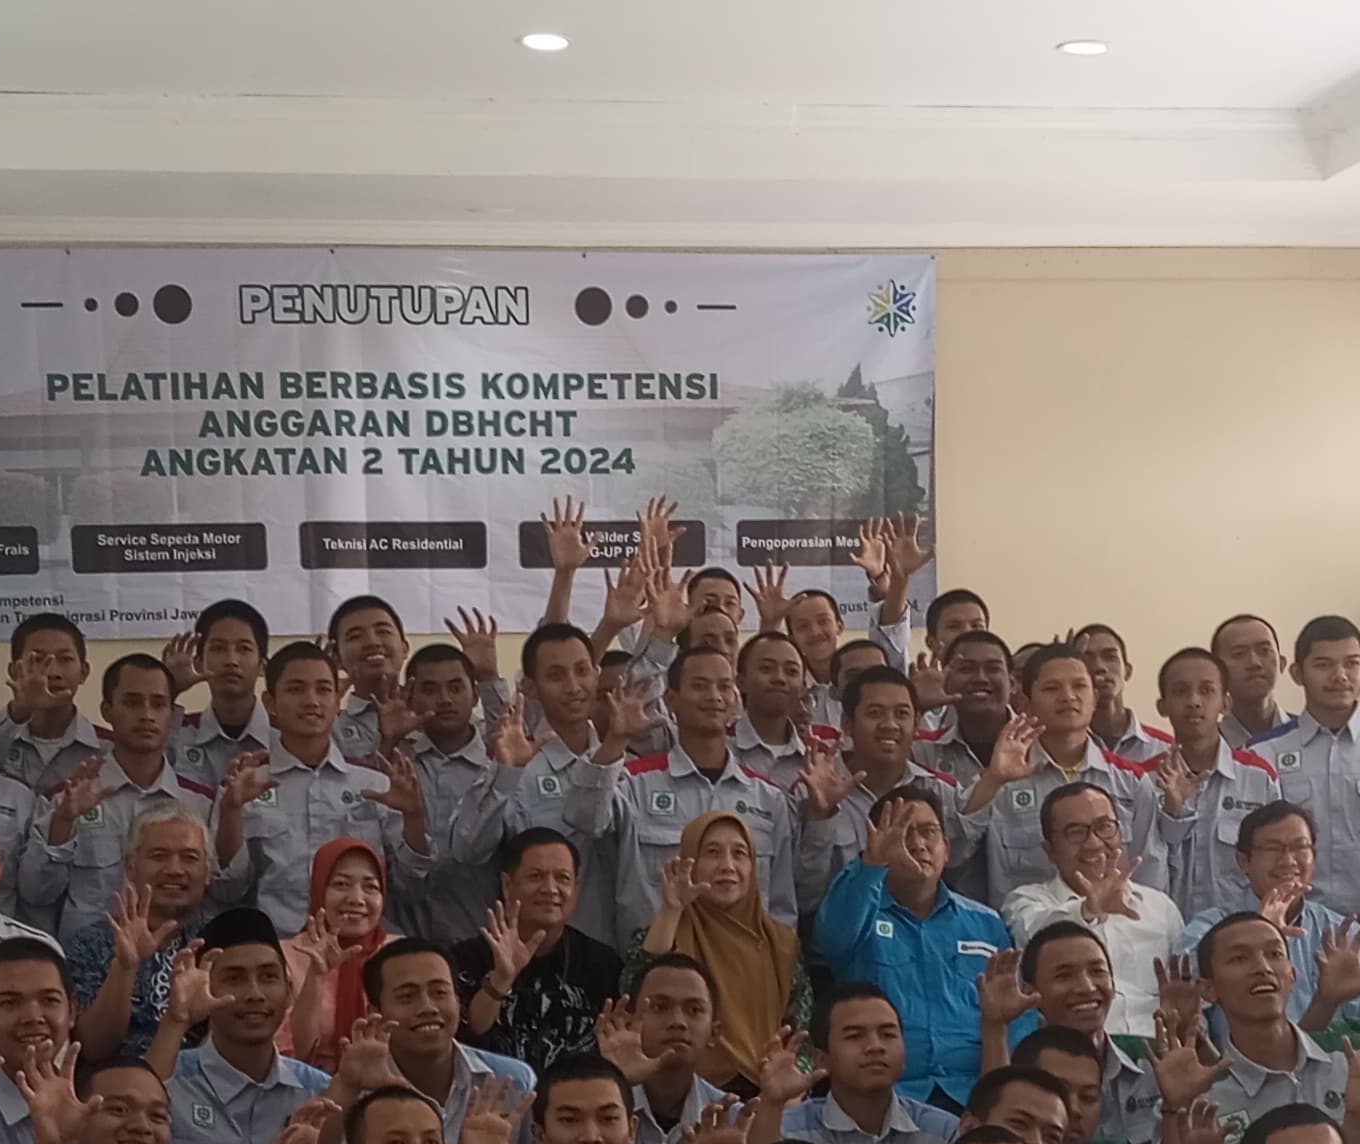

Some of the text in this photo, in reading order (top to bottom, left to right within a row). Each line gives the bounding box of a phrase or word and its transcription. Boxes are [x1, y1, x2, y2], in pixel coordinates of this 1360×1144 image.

[239, 283, 529, 325] PENUTUPAN
[46, 371, 719, 401] PELATIHAN BERBASIS KOMPETENSI
[198, 409, 578, 438] ANGGARAN DBHCHT
[140, 447, 636, 476] ANGKATAN 2 TAHUN 2024
[97, 532, 241, 548] Service Sepeda Motor
[323, 537, 463, 551] Teknisi AC Residential
[742, 536, 860, 551] Pengoperasian Mes
[124, 547, 216, 563] Sistem Injeksi
[109, 608, 168, 623] Provinsi
[170, 608, 201, 622] Jaw
